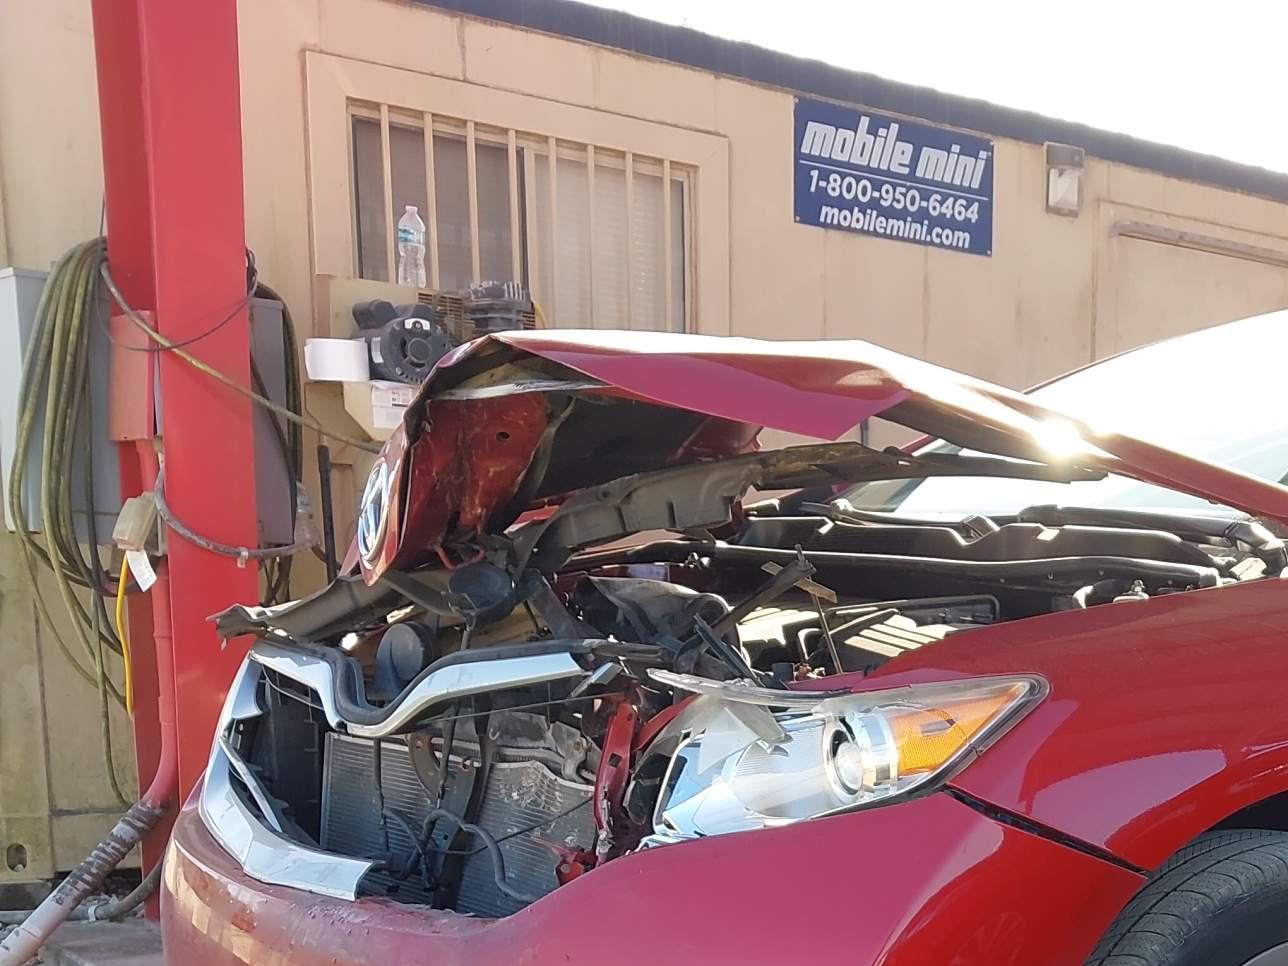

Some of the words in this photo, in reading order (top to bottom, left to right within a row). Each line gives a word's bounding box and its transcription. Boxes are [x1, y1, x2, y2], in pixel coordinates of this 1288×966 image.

[801, 116, 913, 174] mobile
[916, 144, 987, 188] mini
[809, 169, 979, 223] 1-800-950-6464
[819, 205, 970, 248] mobilemini.com
